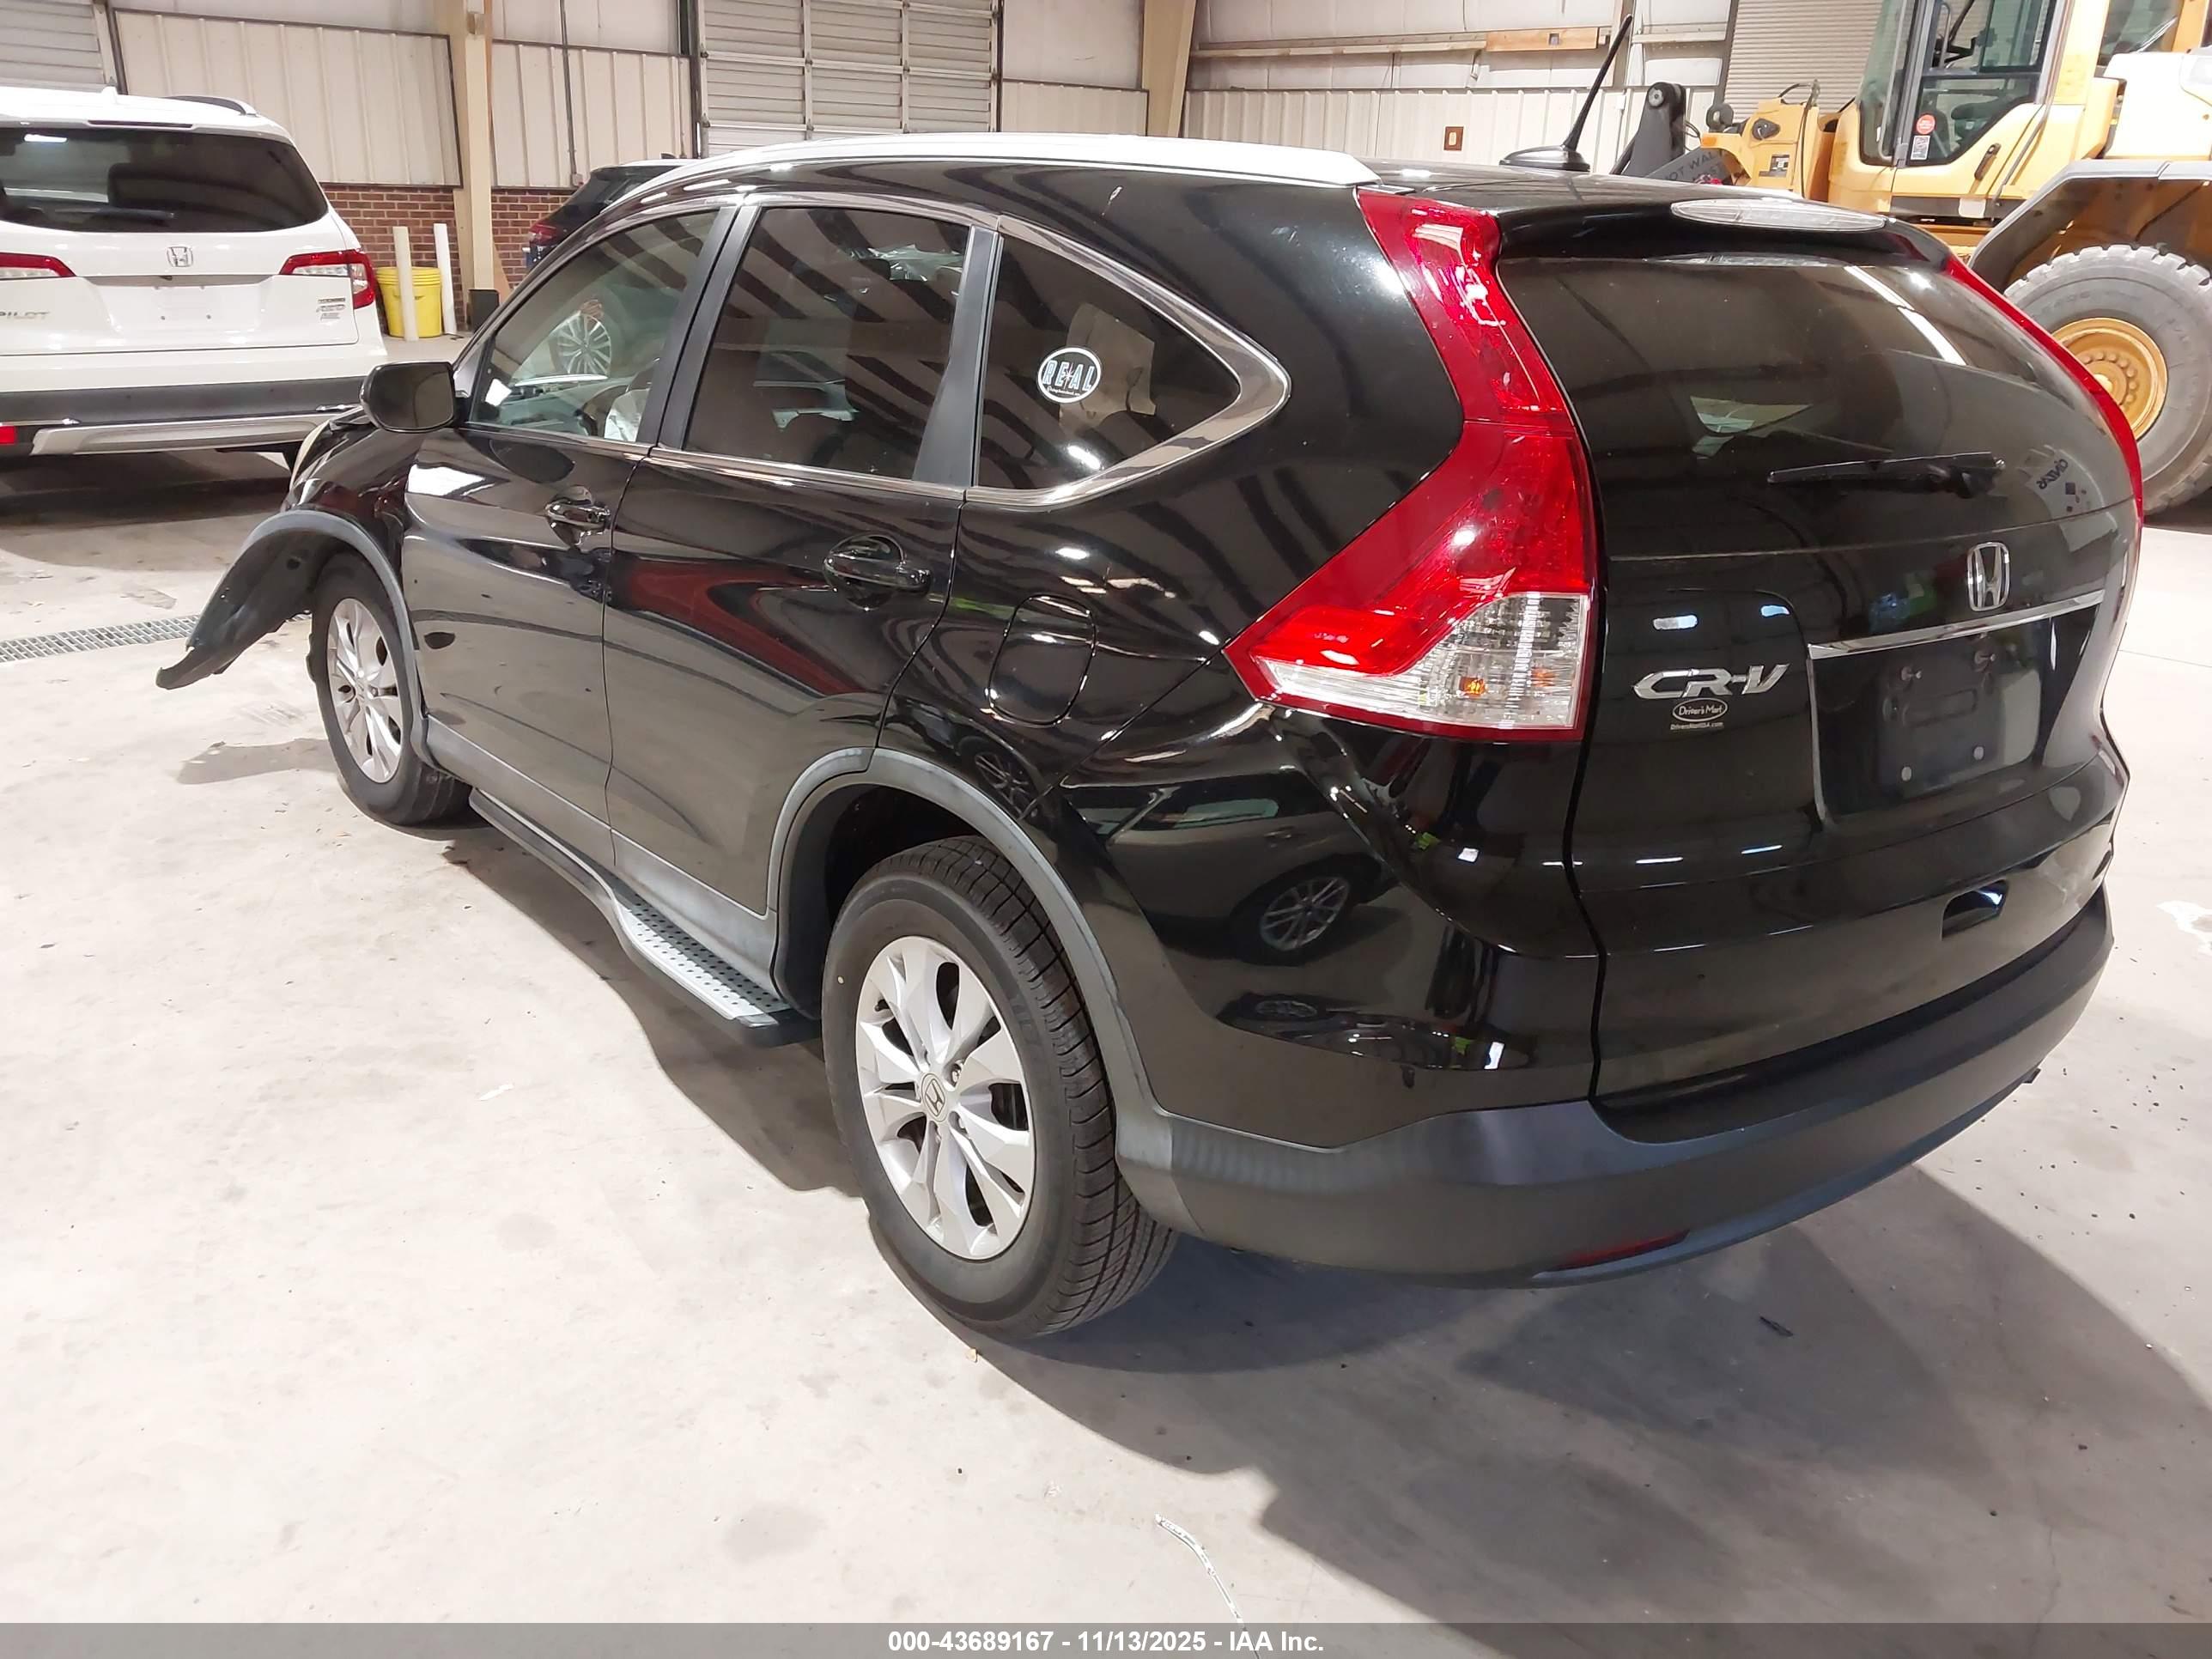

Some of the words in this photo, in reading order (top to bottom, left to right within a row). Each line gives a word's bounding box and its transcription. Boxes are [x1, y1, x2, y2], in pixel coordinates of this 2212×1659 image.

[1042, 360, 1095, 392] REAL
[1632, 663, 1790, 699] CR-V
[1678, 705, 1705, 716] Driver's
[1705, 704, 1723, 714] Mart
